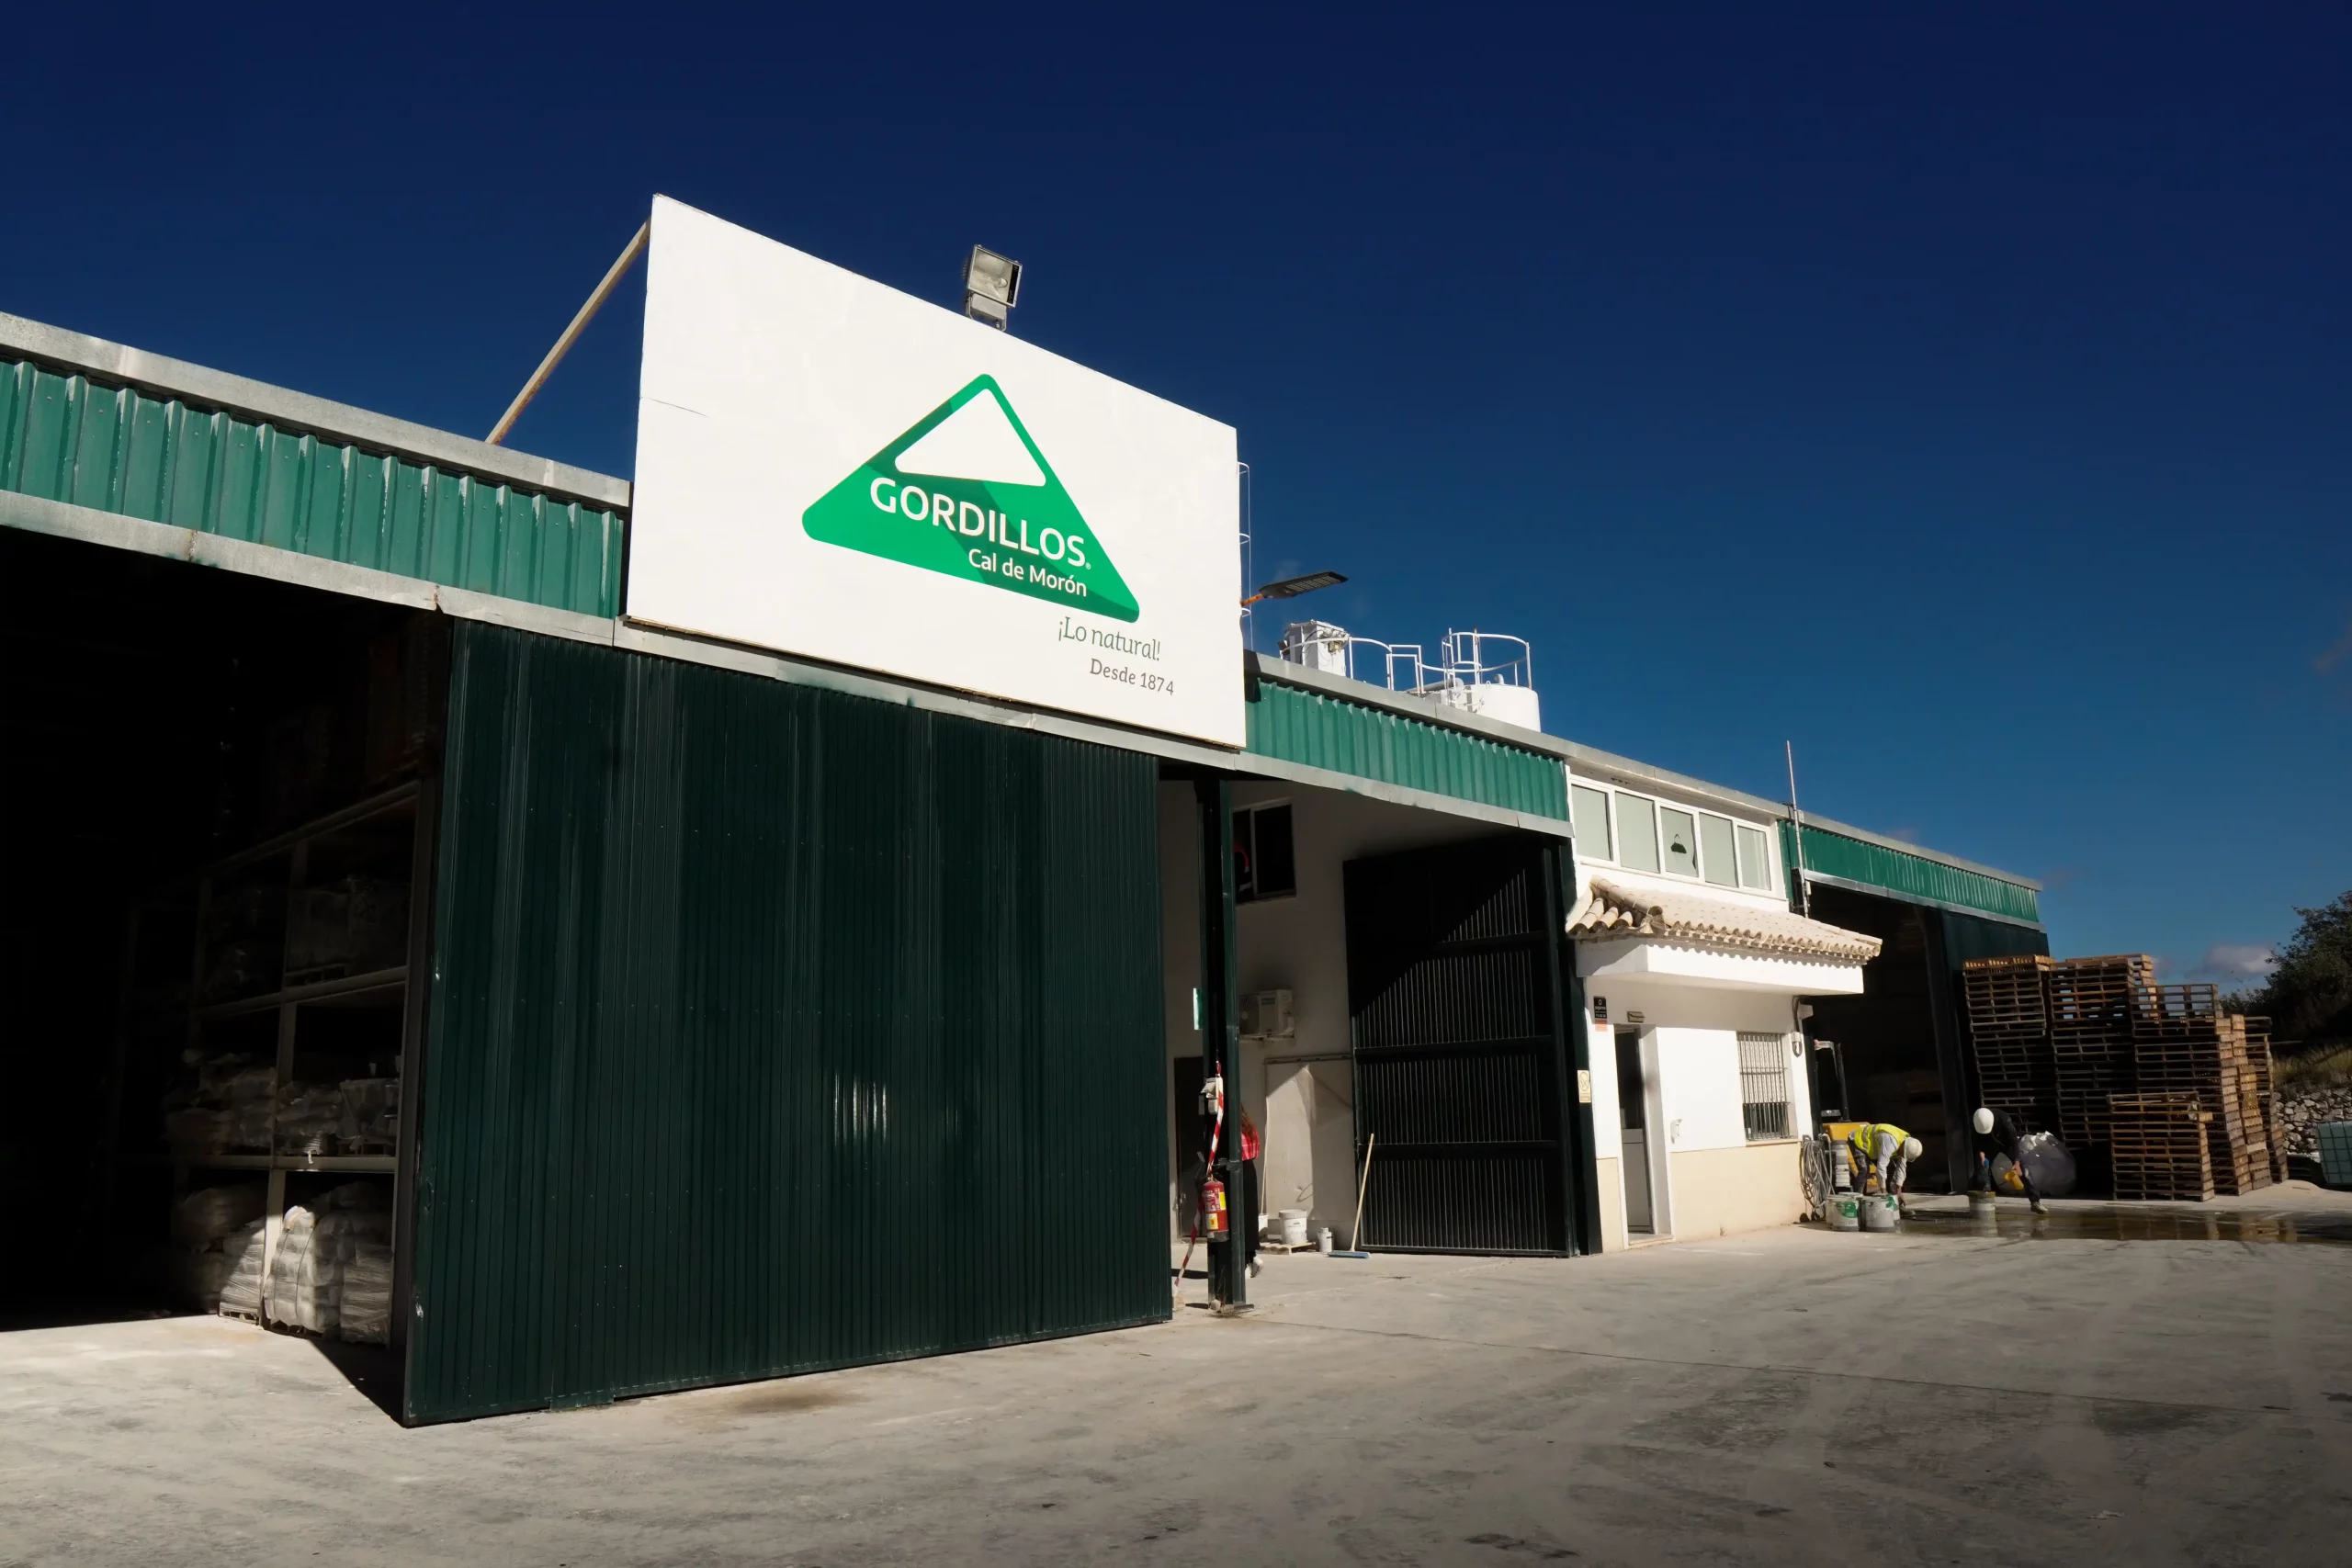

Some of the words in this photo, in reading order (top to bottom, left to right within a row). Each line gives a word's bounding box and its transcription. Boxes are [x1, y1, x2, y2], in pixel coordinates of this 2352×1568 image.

[968, 548, 997, 572] Cal
[1001, 558, 1024, 580] de
[1029, 565, 1087, 597] Morón
[1058, 616, 1087, 642] ¡Lo
[1091, 629, 1160, 661] natural!
[1090, 658, 1136, 685] Desde
[1140, 672, 1174, 696] 1874
